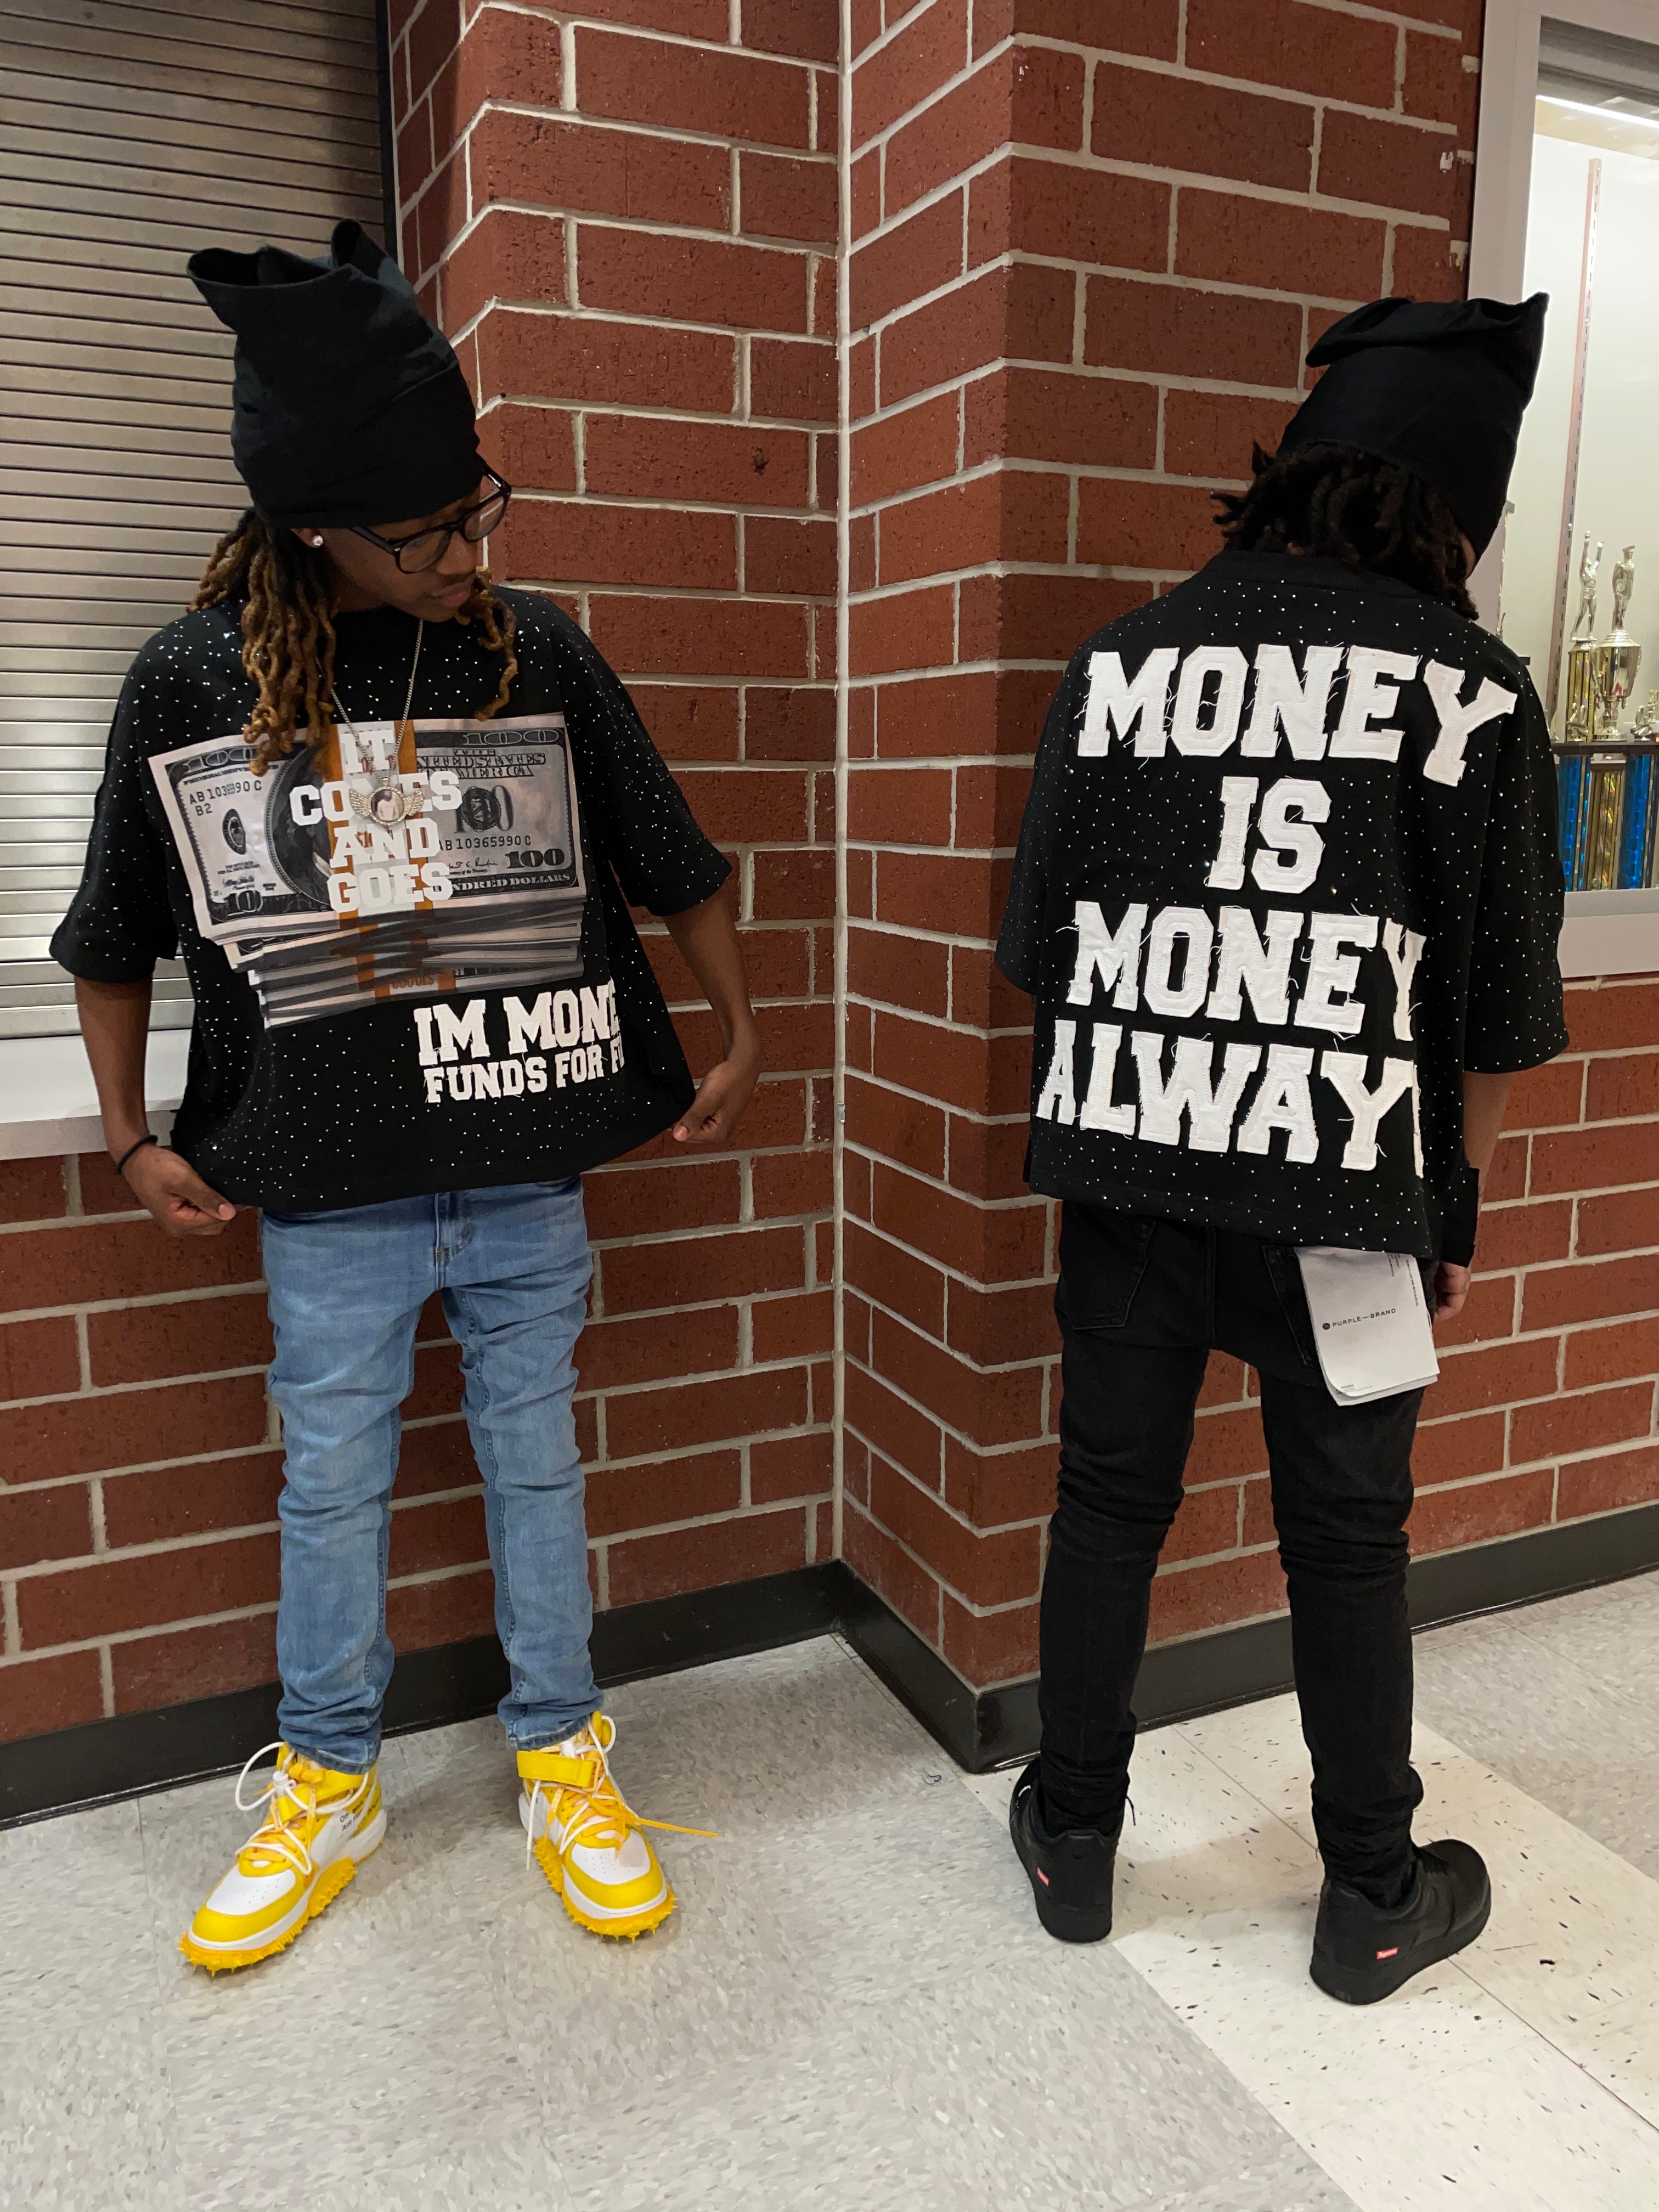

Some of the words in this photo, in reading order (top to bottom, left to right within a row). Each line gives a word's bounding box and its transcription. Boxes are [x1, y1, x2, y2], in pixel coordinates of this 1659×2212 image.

[462, 729, 560, 746] 100
[1077, 644, 1518, 787] MONEY
[341, 729, 394, 774] IT
[189, 791, 205, 804] AB
[195, 803, 212, 816] B2
[289, 770, 462, 826] COES
[330, 817, 440, 868] AND
[456, 835, 522, 850] 10365990
[524, 835, 532, 846] C
[504, 848, 565, 869] 100
[1207, 776, 1332, 894] IS
[327, 862, 453, 913] GOES
[452, 878, 508, 891] NDRED
[510, 873, 571, 887] DOLLARS
[1065, 900, 1426, 1041] MONEY
[414, 999, 491, 1066] IM
[424, 1056, 548, 1103] FUNDS
[555, 1045, 605, 1088] FOR
[1036, 1019, 1424, 1179] ALWAY
